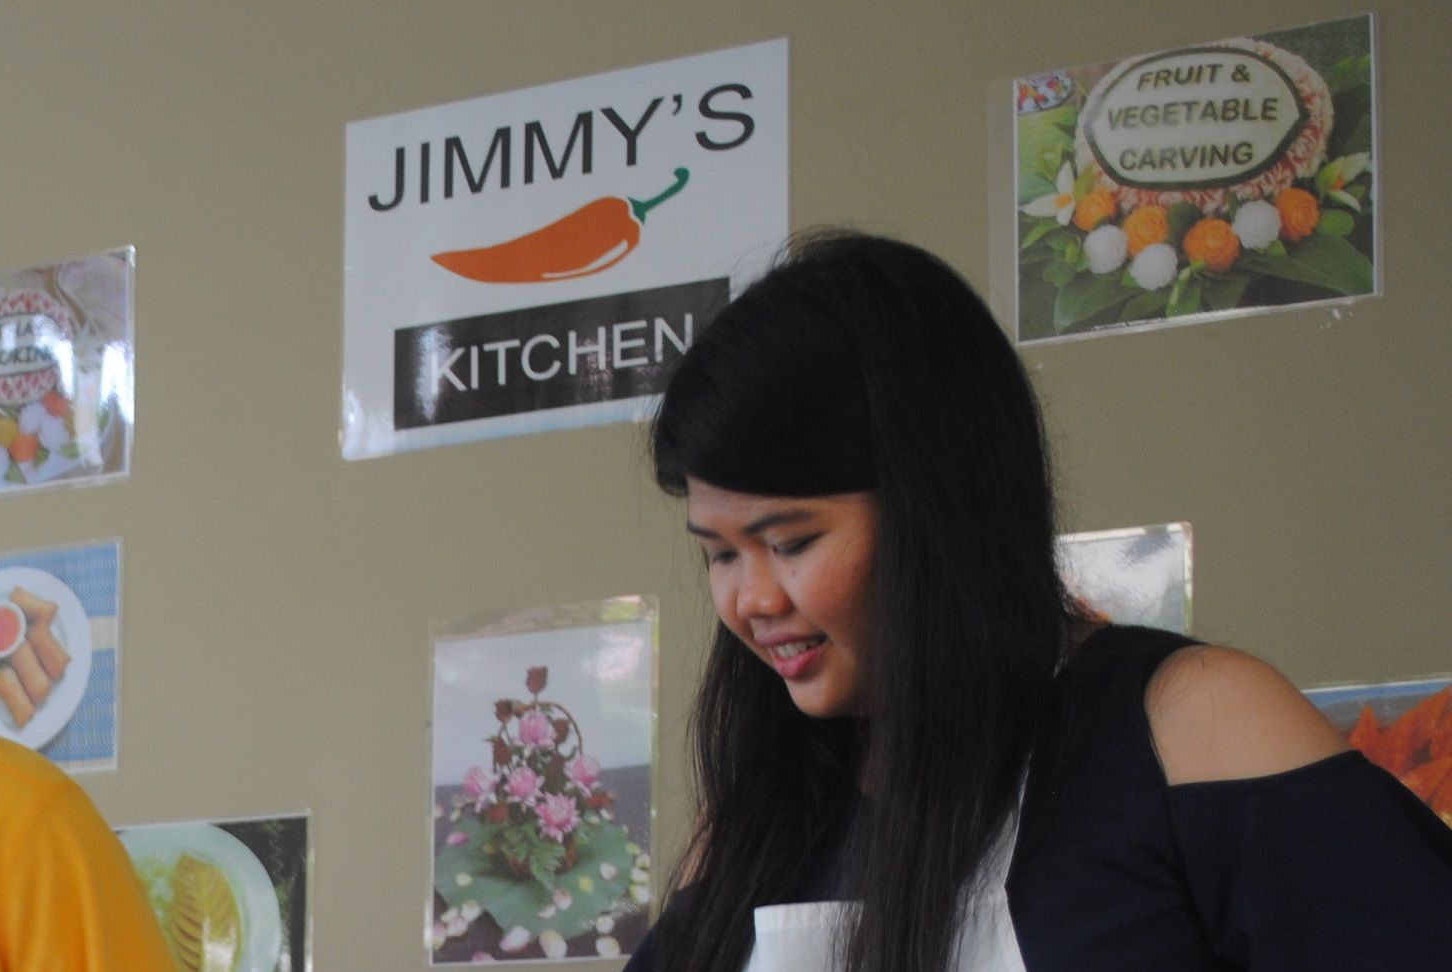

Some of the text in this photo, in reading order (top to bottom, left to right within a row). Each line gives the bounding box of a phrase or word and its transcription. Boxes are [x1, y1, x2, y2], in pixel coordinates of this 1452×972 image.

[1136, 63, 1251, 91] FRUIT &
[1108, 97, 1279, 131] VEGETABLE
[367, 82, 756, 212] JIMMY'S
[1118, 141, 1254, 171] CARVING
[430, 312, 694, 396] KITCHEN
